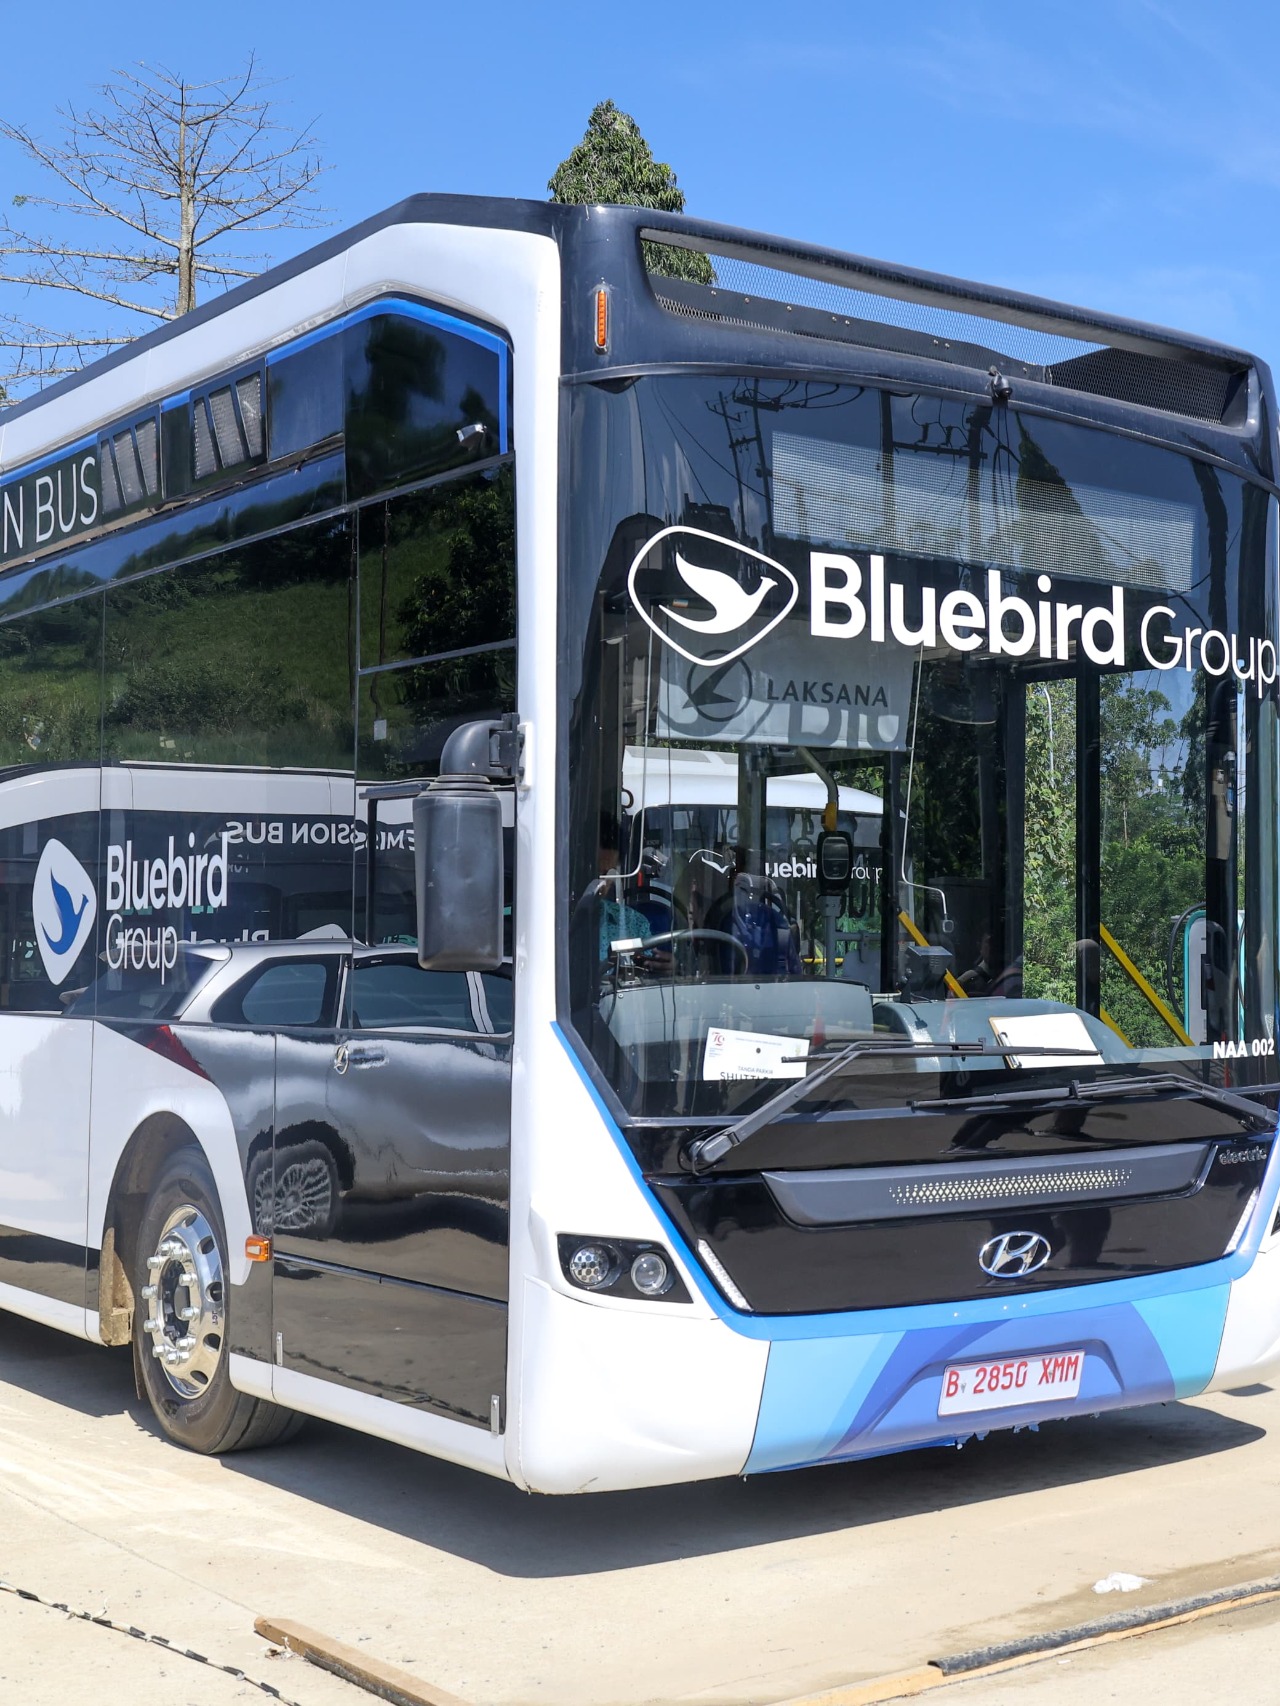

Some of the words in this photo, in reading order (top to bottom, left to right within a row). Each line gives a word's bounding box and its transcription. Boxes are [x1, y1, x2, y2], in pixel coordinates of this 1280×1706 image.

[4, 486, 24, 554] N
[36, 456, 98, 543] BUS
[809, 551, 1126, 667] Bluebird
[1140, 605, 1278, 700] Group
[767, 678, 889, 709] LAKSANA
[106, 831, 228, 911] Bluebird
[105, 913, 178, 986] Group
[1213, 1041, 1249, 1060] NAA
[1251, 1038, 1275, 1057] 002
[946, 1370, 960, 1398] B
[973, 1361, 1029, 1395] 2850
[1038, 1355, 1080, 1386] XMM
